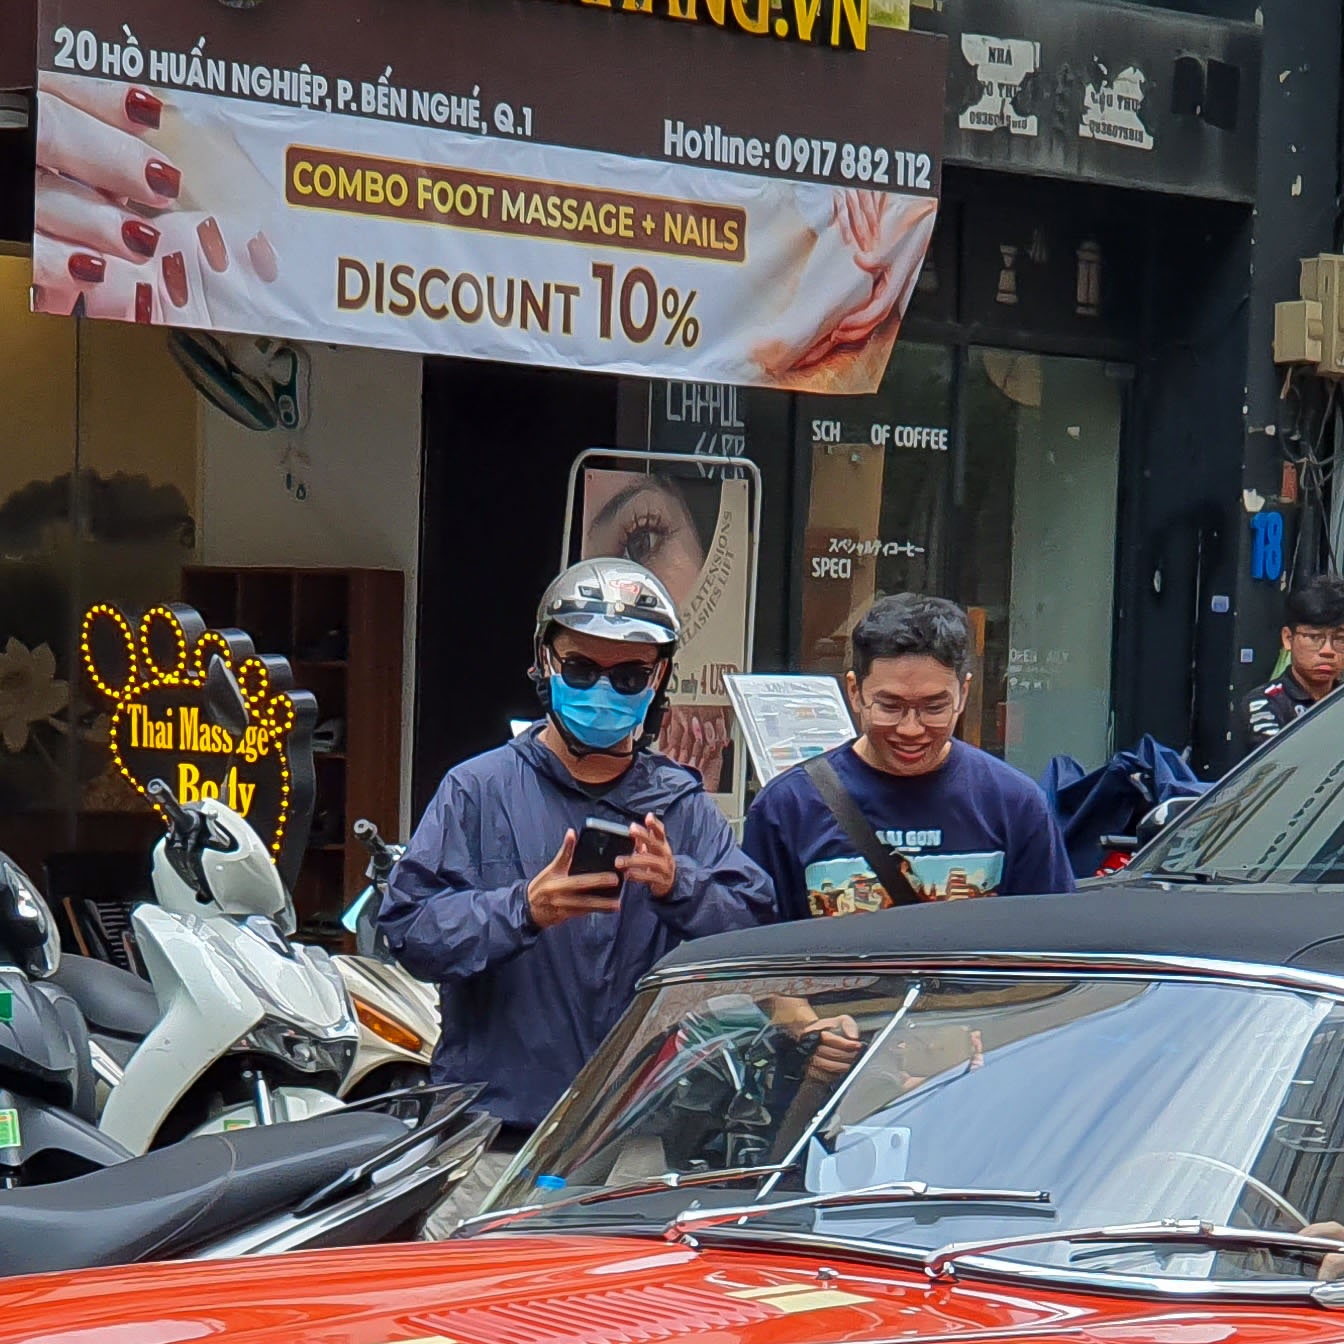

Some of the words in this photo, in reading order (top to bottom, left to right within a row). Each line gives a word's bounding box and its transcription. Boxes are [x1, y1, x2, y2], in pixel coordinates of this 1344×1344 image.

[54, 25, 98, 70] 20
[101, 24, 144, 78] HỒ
[149, 36, 226, 93] HUẤN
[231, 64, 332, 113] NGHIỆP,
[337, 79, 357, 111] P.
[361, 65, 407, 117] BẾN
[412, 85, 488, 135] NGHÉ,
[494, 103, 533, 136] Q.1
[663, 119, 770, 170] Hotline:
[774, 134, 838, 177] 0917
[840, 143, 889, 185] 882
[894, 150, 932, 190] 112
[292, 161, 409, 208] COMBO
[417, 176, 495, 220] FOOT
[501, 190, 635, 238] MASSAGE
[663, 211, 740, 252] NAILS
[337, 257, 581, 336] DISCOUNT
[592, 262, 701, 349] 10%
[871, 424, 891, 445] OF
[894, 425, 948, 450] COFFEE
[1250, 511, 1283, 580] 18
[126, 703, 173, 749] Thai
